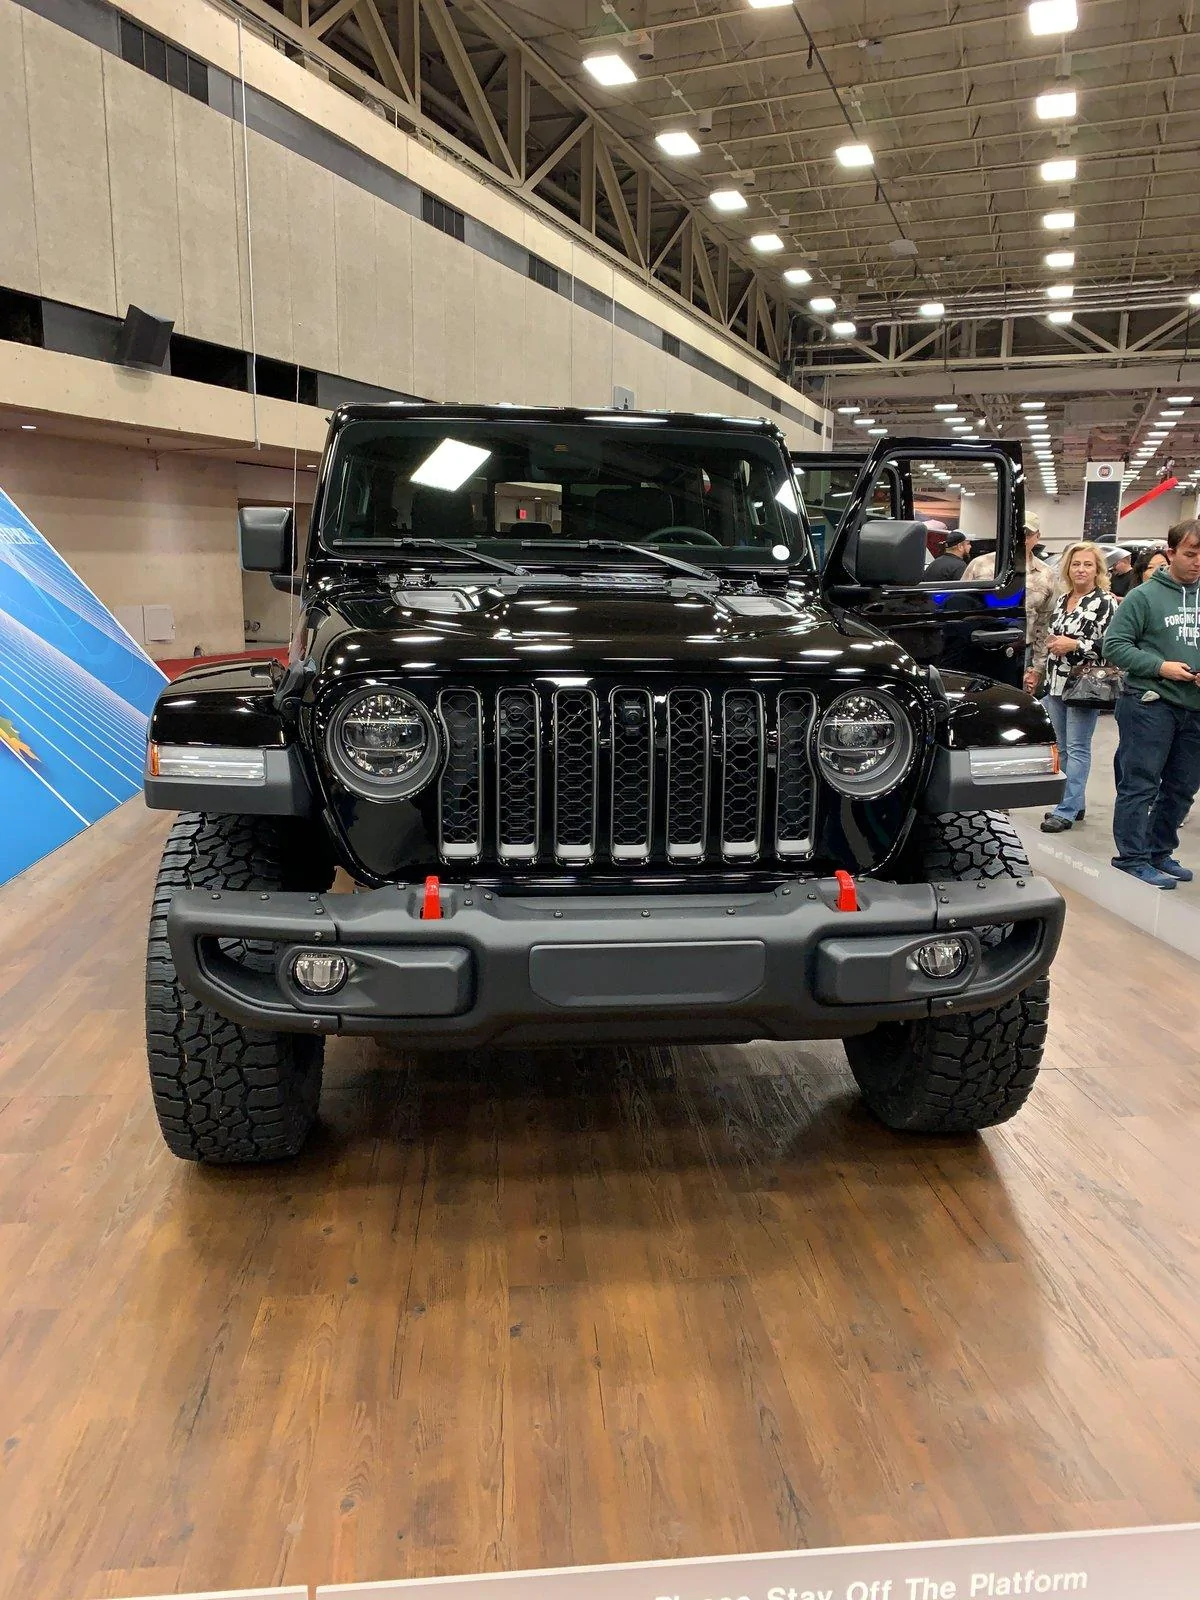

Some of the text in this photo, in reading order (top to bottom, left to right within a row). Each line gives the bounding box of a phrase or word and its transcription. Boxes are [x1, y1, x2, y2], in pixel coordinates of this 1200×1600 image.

[846, 1580, 893, 1600] Off
[905, 1577, 957, 1600] The
[970, 1570, 1088, 1597] Platform
